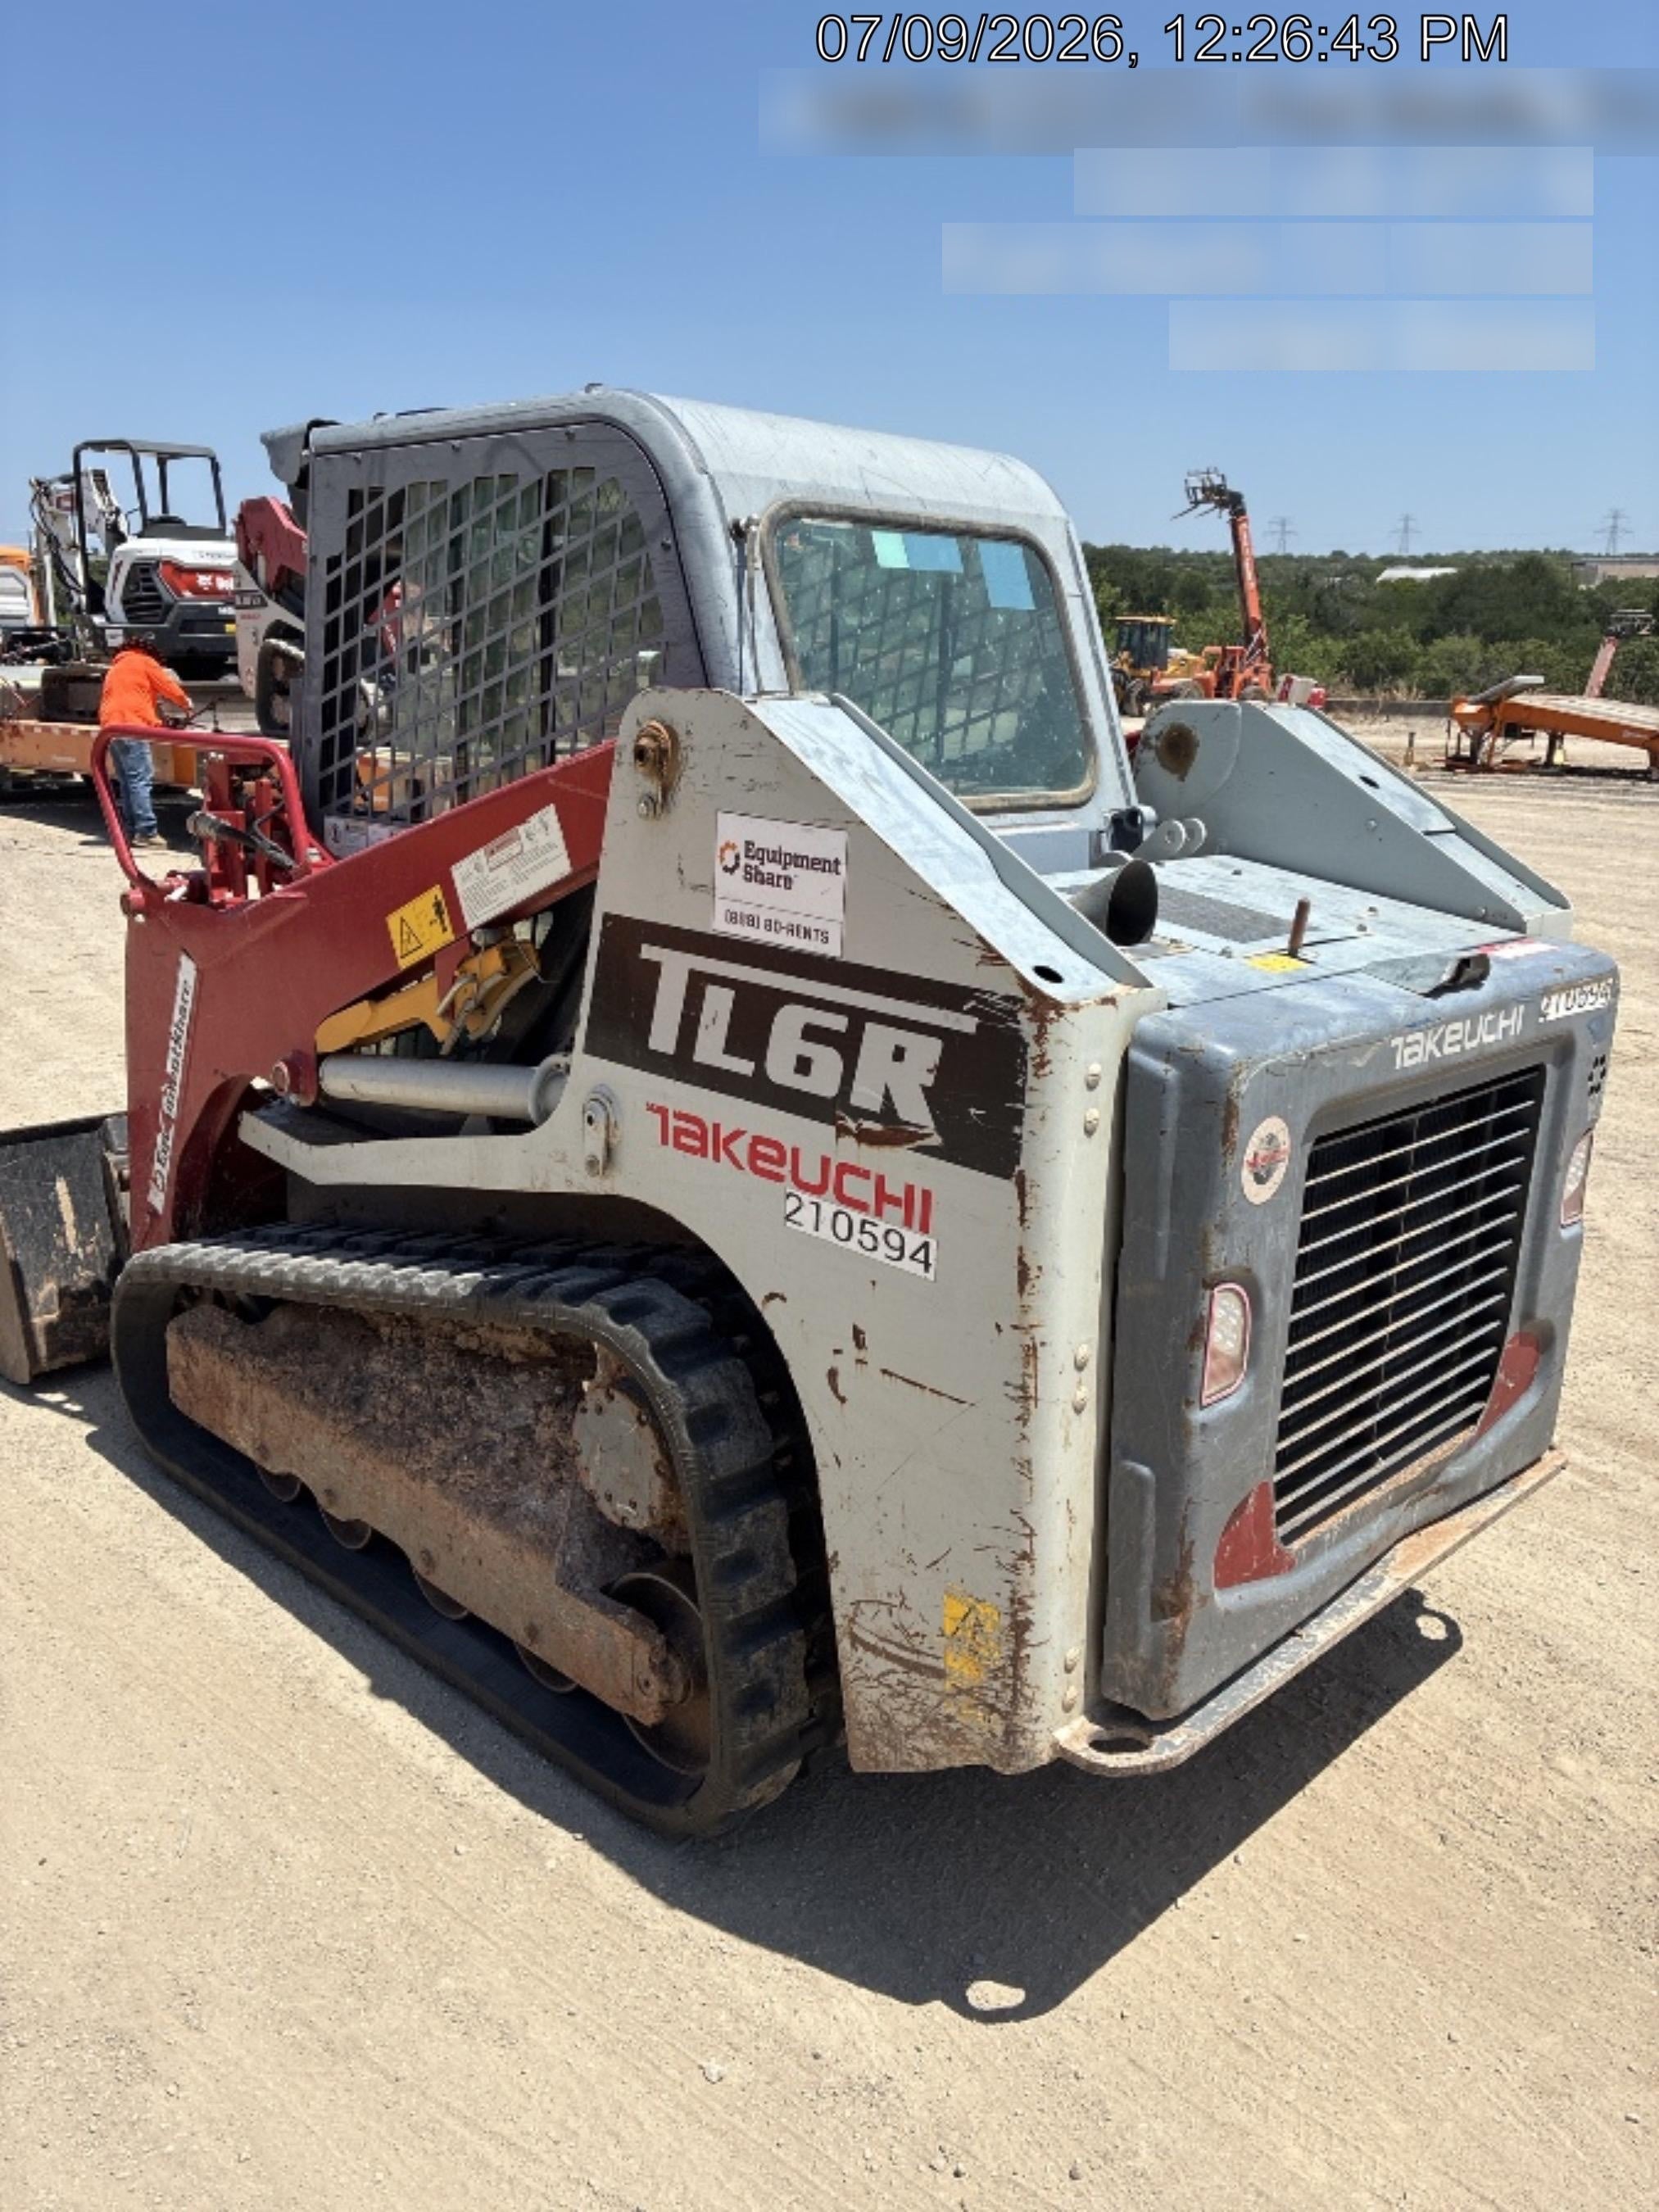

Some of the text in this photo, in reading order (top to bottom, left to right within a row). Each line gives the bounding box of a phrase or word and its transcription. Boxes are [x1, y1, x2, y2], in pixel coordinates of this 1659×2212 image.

[743, 862, 793, 891] Share
[744, 840, 841, 876] Equipment
[639, 943, 981, 1147] TL6R
[783, 1191, 932, 1274] 210594
